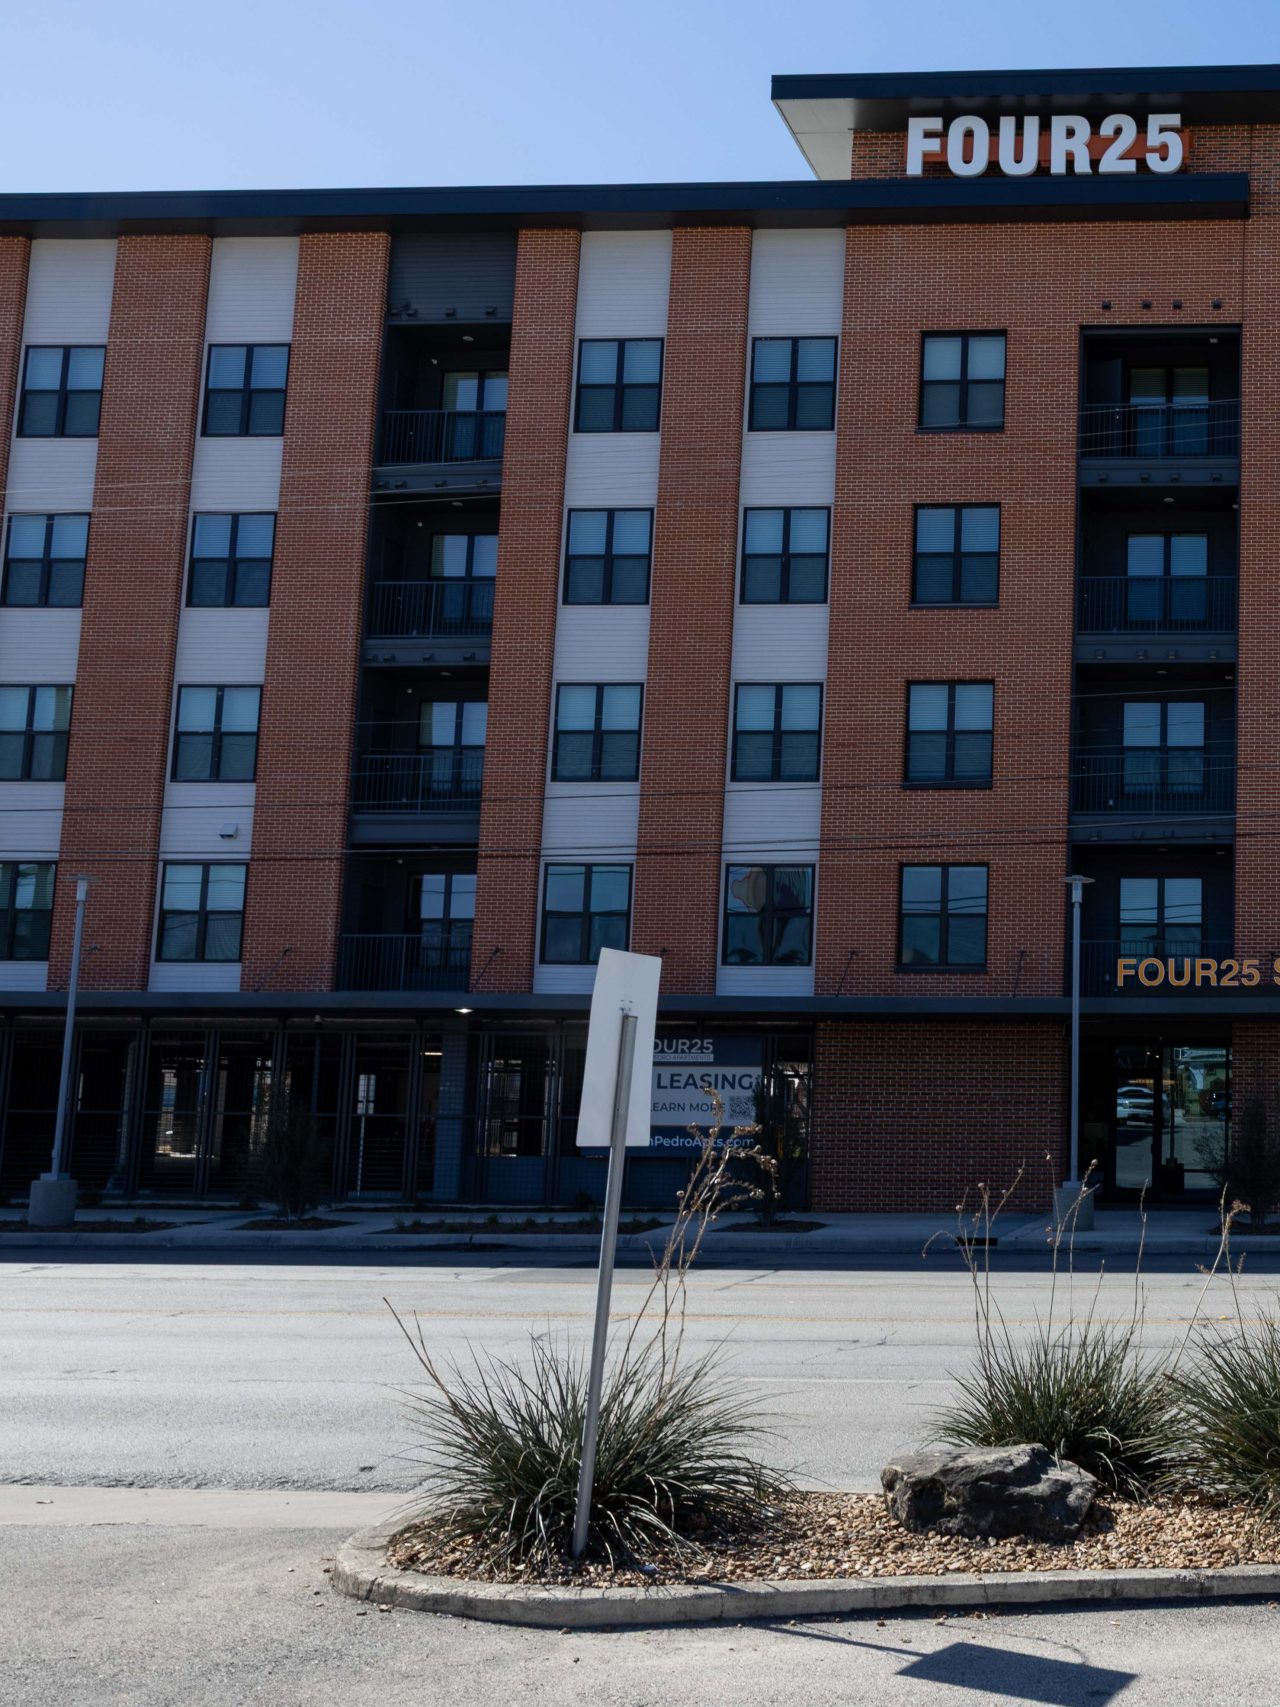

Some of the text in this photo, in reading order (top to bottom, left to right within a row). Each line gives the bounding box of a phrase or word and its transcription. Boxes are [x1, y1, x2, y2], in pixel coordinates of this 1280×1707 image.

[906, 113, 1184, 177] FOUR25
[1116, 958, 1261, 987] FOUR25
[651, 1102, 686, 1112] EARN
